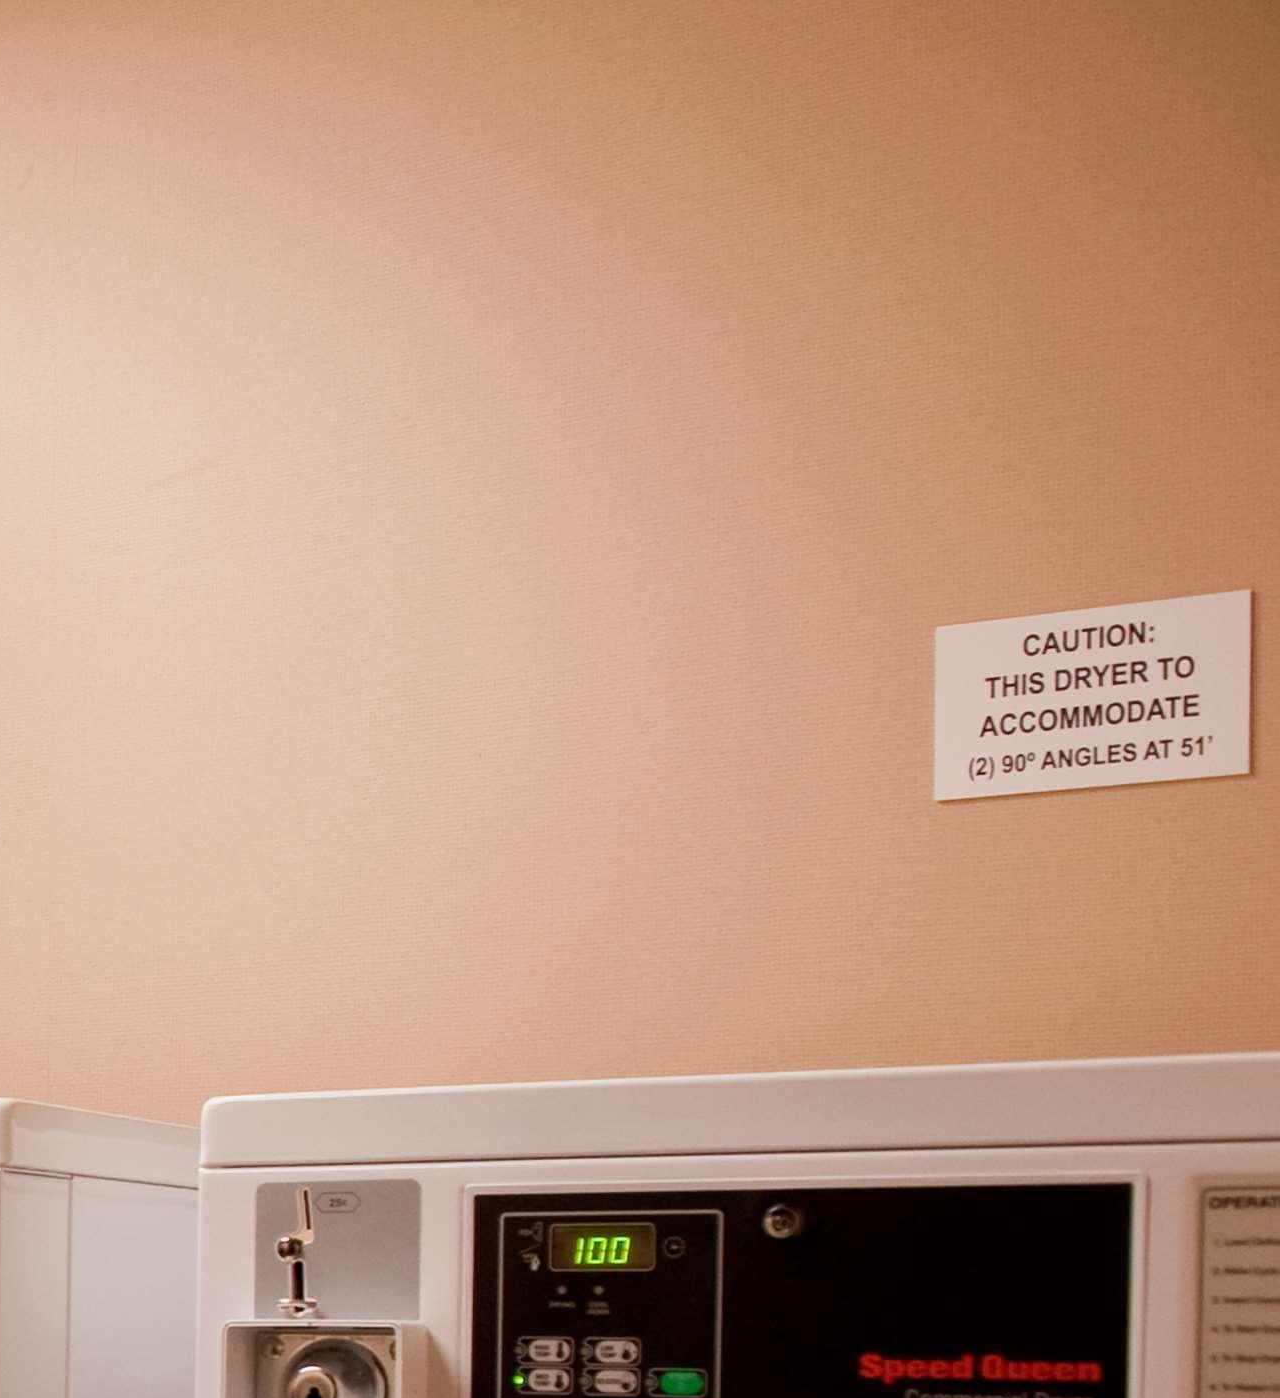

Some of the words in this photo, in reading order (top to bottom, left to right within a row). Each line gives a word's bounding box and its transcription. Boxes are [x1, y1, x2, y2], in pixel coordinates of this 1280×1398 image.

[1023, 622, 1156, 656] CAUTION:
[985, 672, 1045, 698] THIS
[1055, 660, 1149, 692] DRYER
[1157, 656, 1195, 680] TO
[980, 694, 1200, 738] ACCOMMODATE
[968, 757, 995, 781] (2)
[1041, 743, 1137, 770] ANGLES
[1144, 739, 1174, 761] AT
[574, 1236, 631, 1265] 100
[858, 1352, 975, 1384] Speed
[979, 1354, 1103, 1382] Queen
